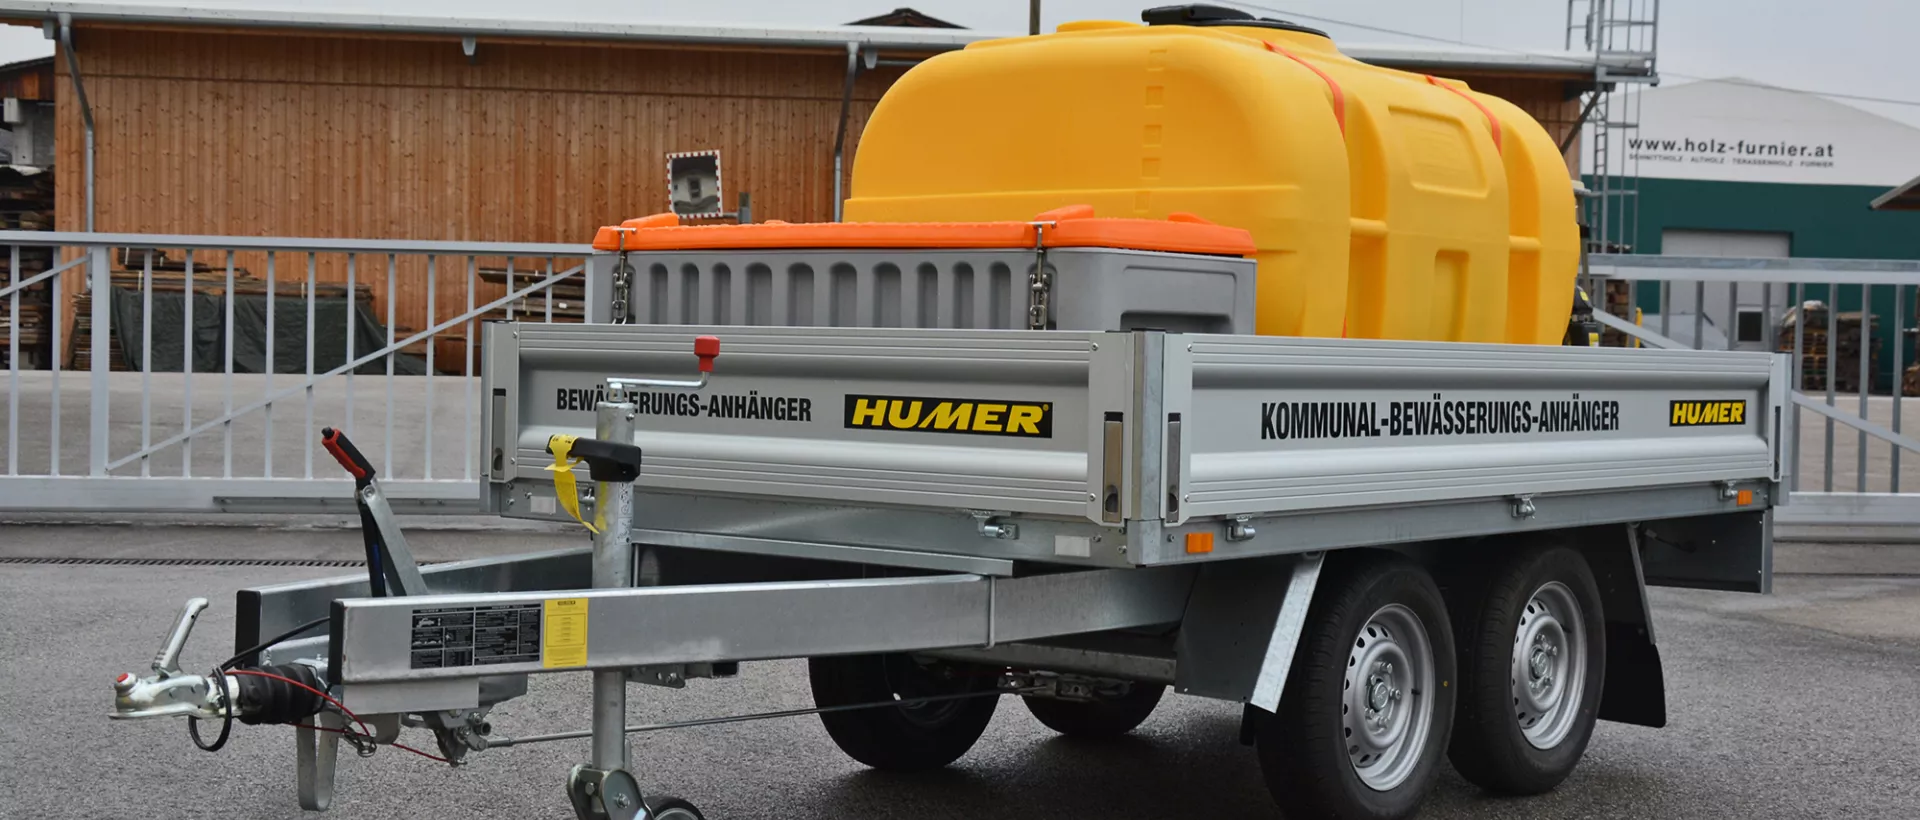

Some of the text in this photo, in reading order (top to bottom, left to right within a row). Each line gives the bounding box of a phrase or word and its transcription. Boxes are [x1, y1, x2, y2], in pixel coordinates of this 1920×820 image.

[1628, 137, 1834, 158] www.holz-furnier.at
[556, 385, 812, 422] BEWÄERUNGS-ANHÄNGER
[852, 398, 1044, 434] HUMER
[1260, 393, 1620, 440] KOMMUNAL-BEWÄSSERUNGS-ANHÄNGER
[1672, 402, 1744, 424] HUMER
